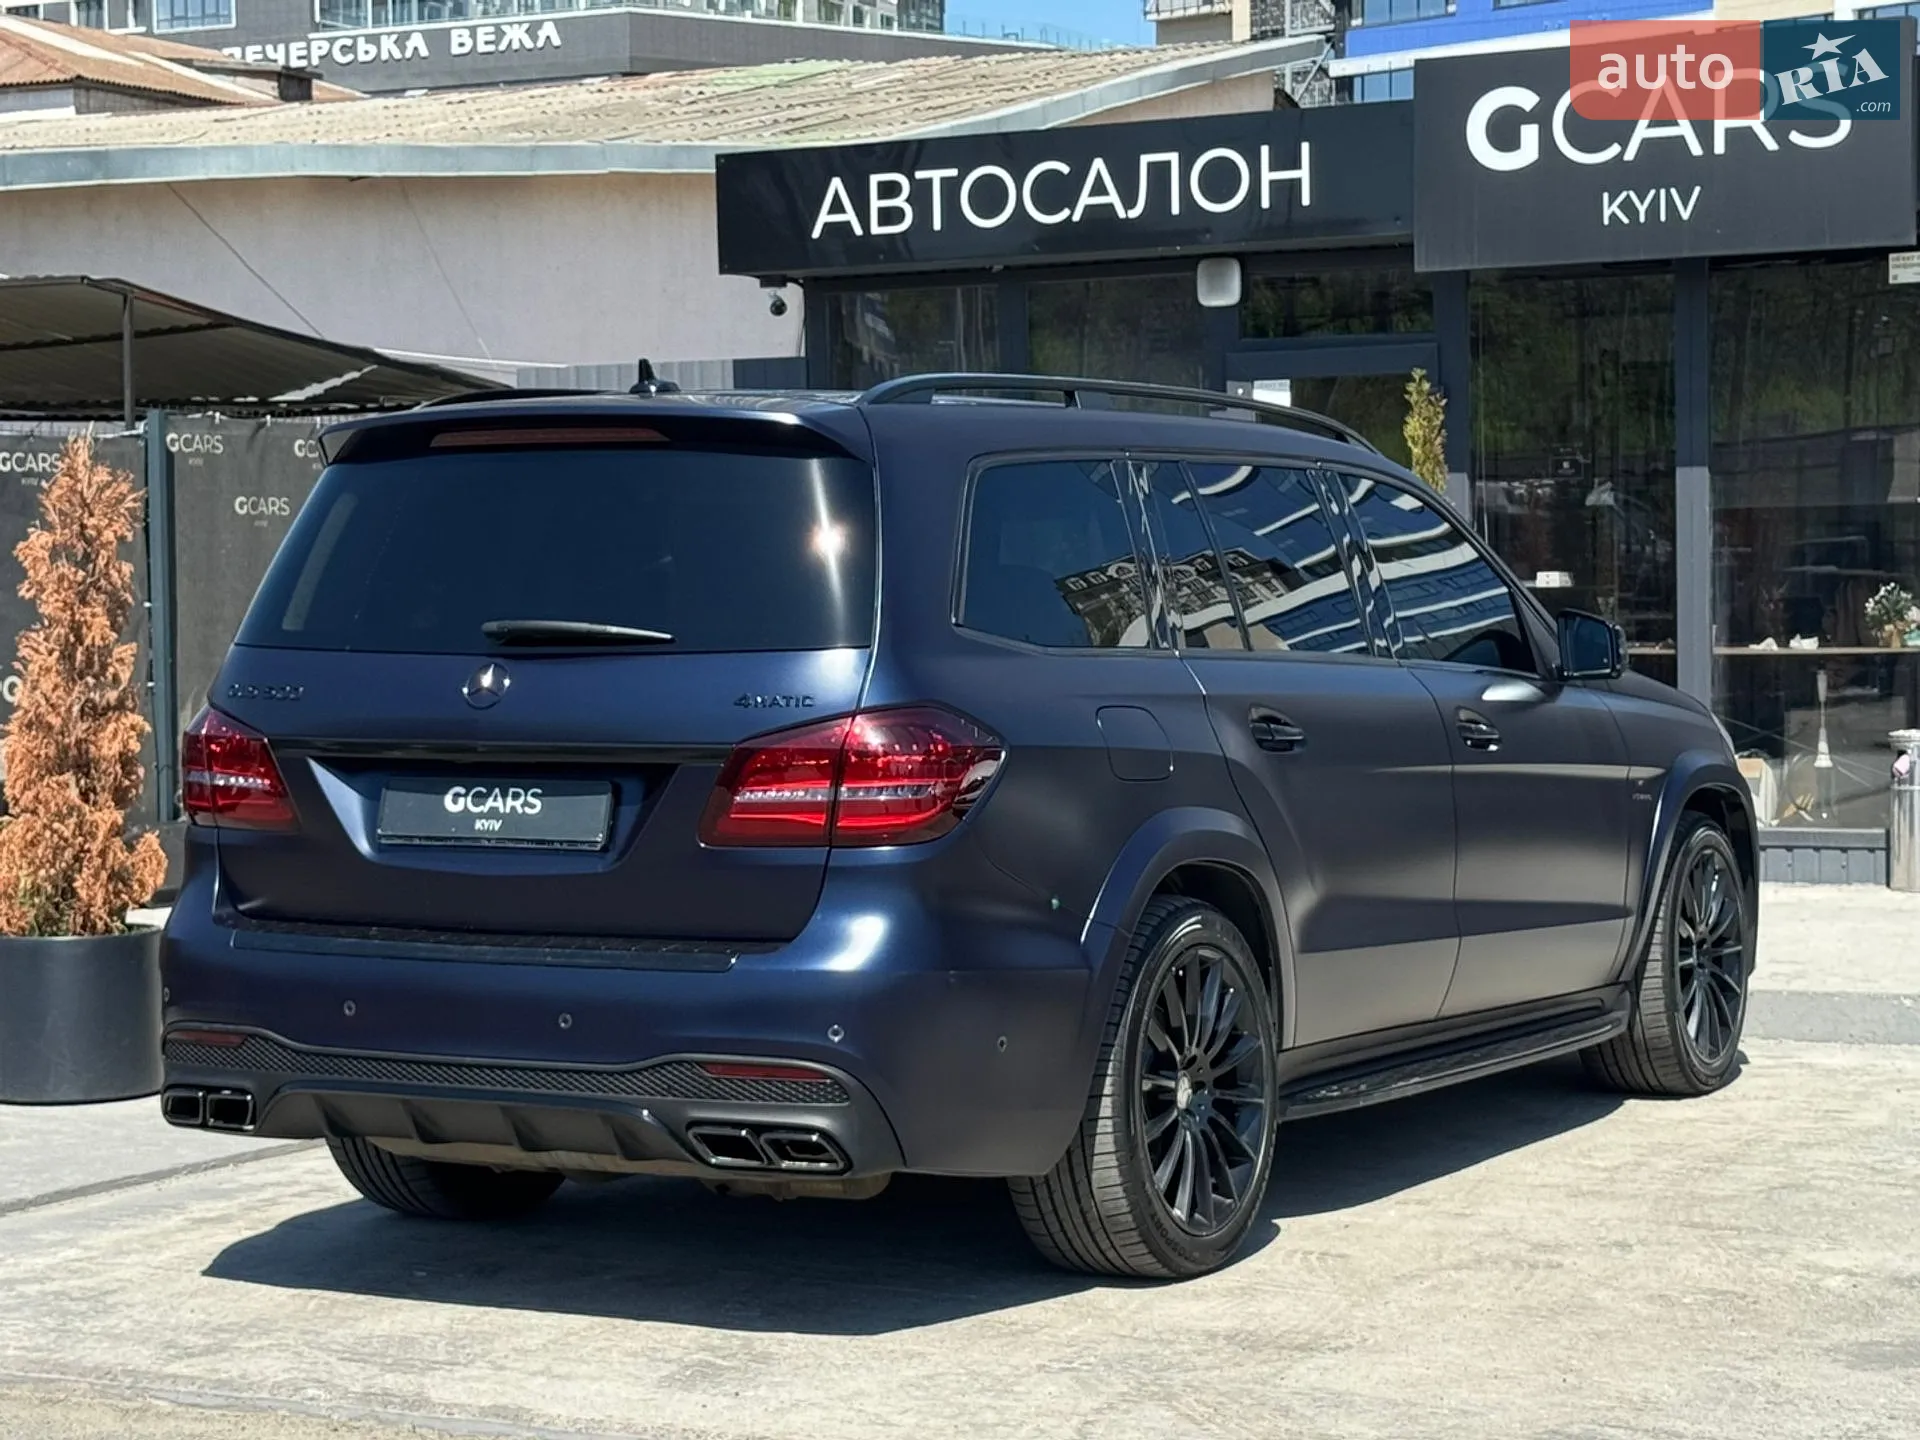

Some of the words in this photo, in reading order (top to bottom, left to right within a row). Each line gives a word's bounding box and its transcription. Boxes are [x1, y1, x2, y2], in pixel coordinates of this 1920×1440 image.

[450, 21, 562, 56] ВЕЖА
[1466, 61, 1853, 171] GCARS
[811, 141, 1311, 240] АВТОСАЛОН
[1602, 186, 1701, 226] KYIV
[166, 432, 224, 454] GCARS
[0, 451, 61, 472] GCARS
[234, 496, 290, 516] GCARS
[444, 786, 542, 814] GCARS
[474, 818, 503, 831] KYIV
